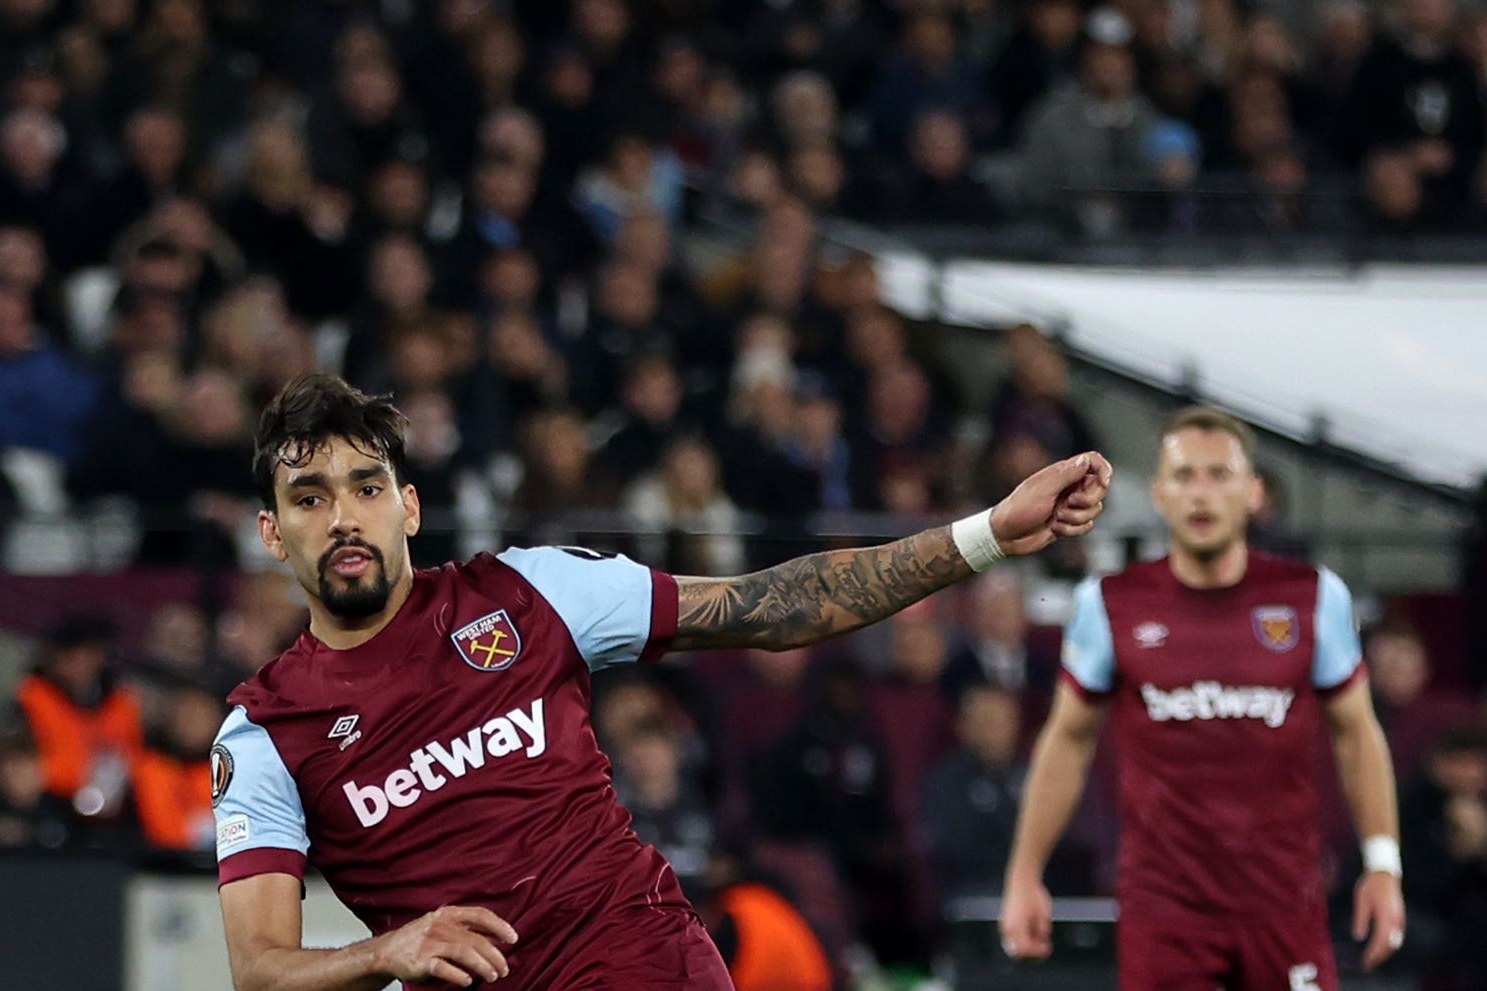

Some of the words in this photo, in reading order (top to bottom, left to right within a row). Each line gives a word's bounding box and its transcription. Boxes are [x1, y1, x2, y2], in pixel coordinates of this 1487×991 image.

[457, 625, 480, 641] WEST
[480, 615, 502, 627] HAM
[1140, 680, 1295, 728] betway
[338, 730, 362, 751] umbro
[342, 697, 547, 828] betway
